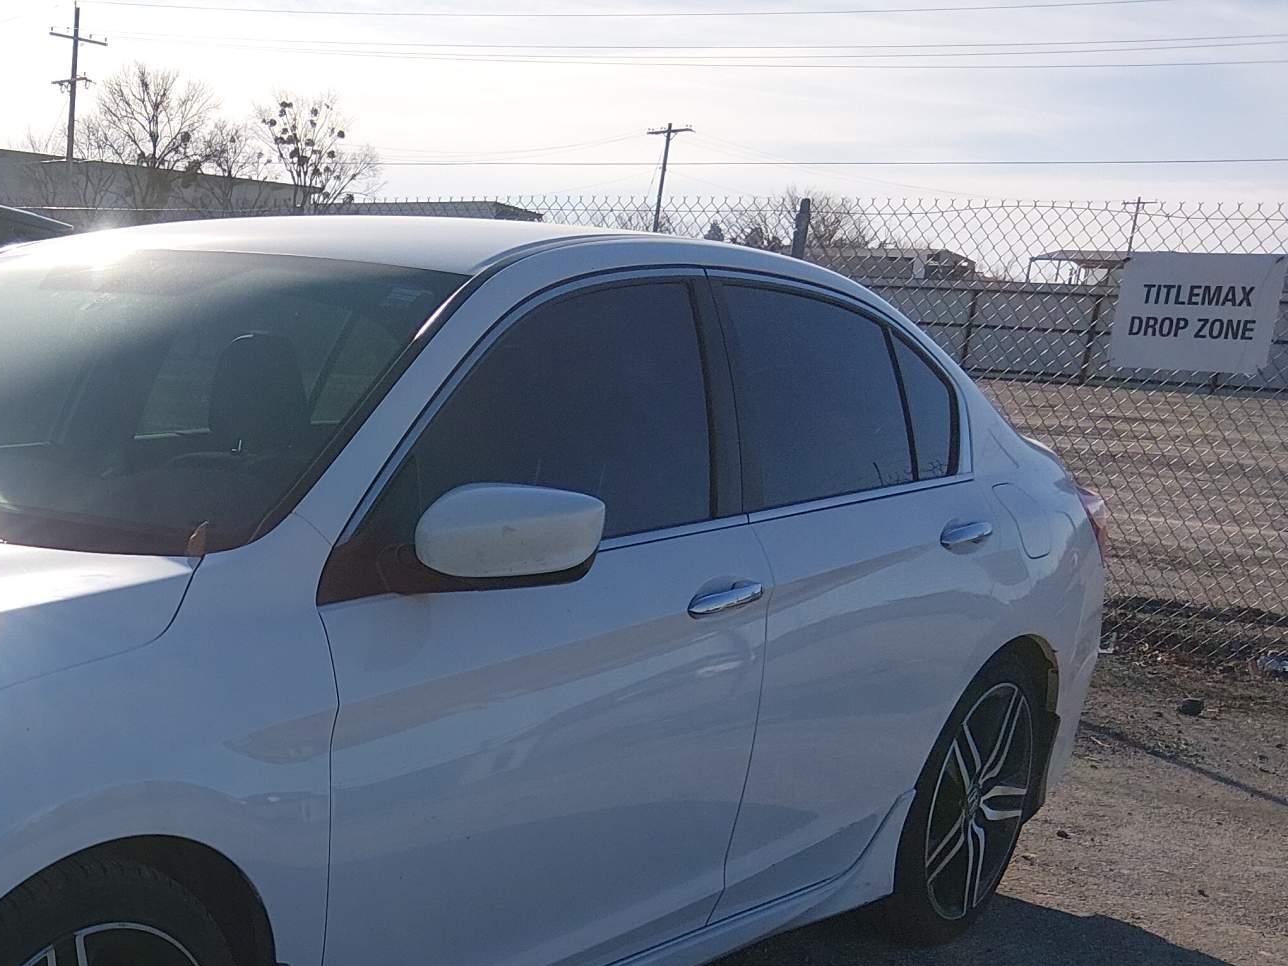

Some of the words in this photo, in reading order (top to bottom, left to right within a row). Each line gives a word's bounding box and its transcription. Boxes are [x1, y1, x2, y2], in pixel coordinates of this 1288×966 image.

[1143, 283, 1256, 307] TITLEMAX
[1128, 315, 1189, 337] DROP
[1193, 318, 1257, 341] ZONE
